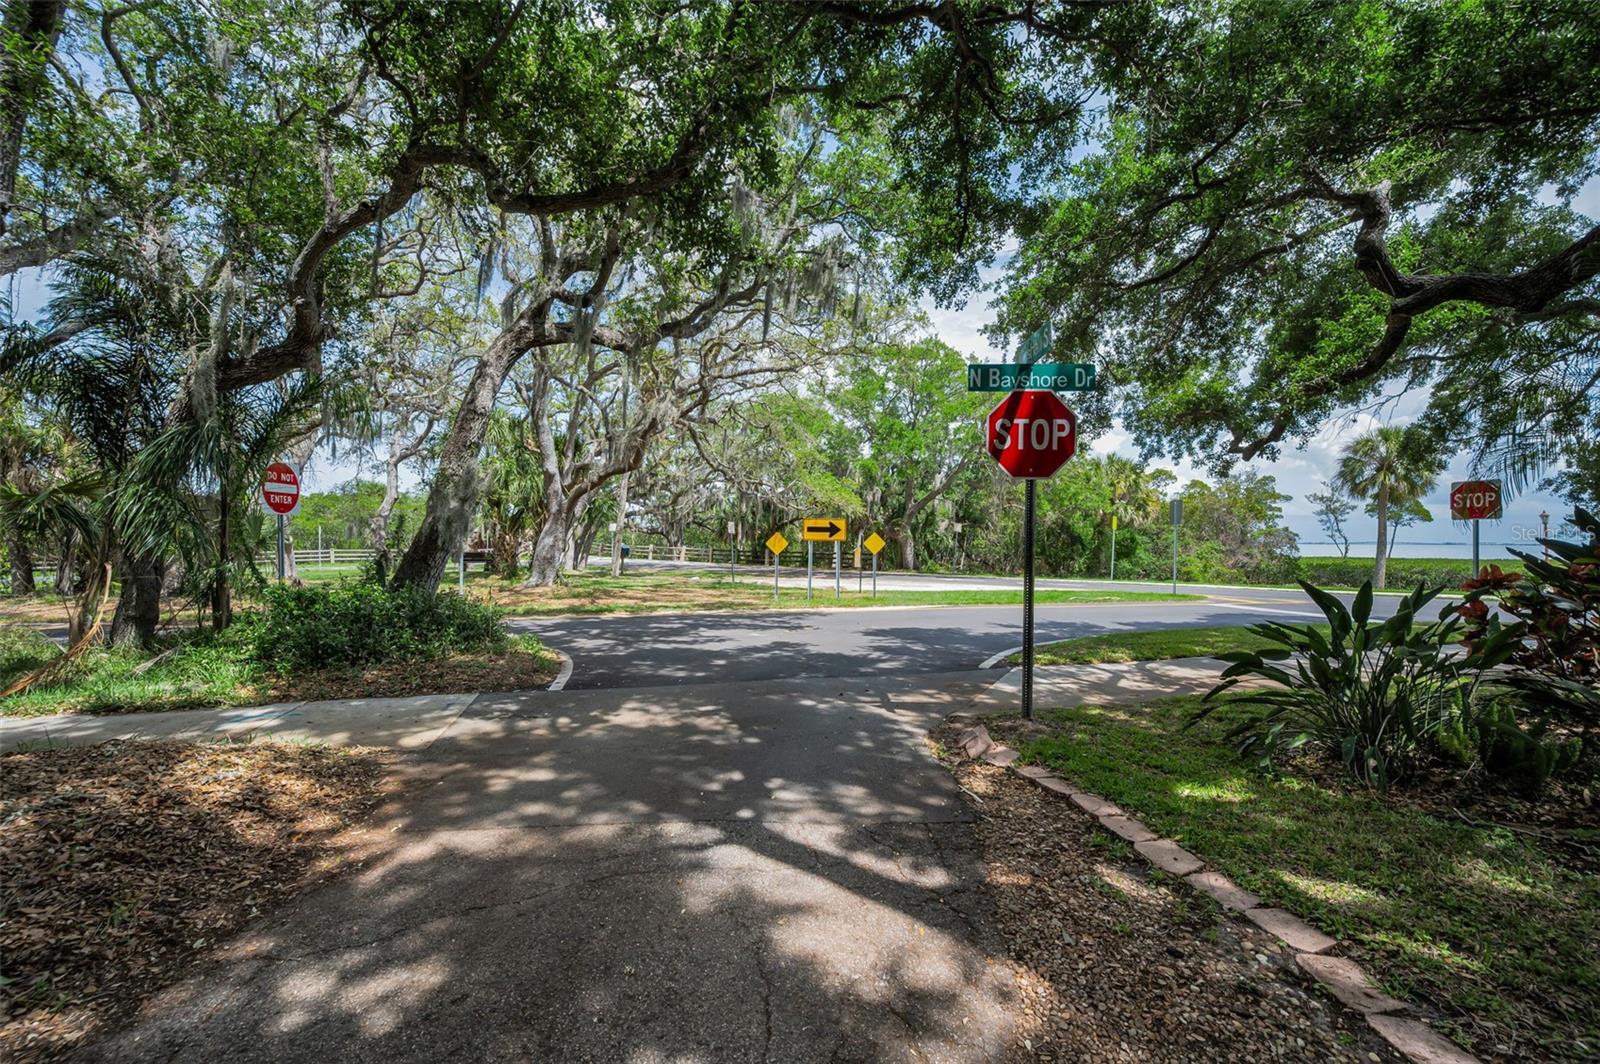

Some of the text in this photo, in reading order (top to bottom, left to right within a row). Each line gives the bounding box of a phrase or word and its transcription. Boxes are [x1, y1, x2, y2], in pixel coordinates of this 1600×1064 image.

[969, 368, 1093, 389] N Bayshore Dr
[994, 418, 1071, 450] STOP
[267, 471, 294, 482] DO NOT
[270, 494, 292, 504] ENTER
[1454, 492, 1496, 508] STOP
